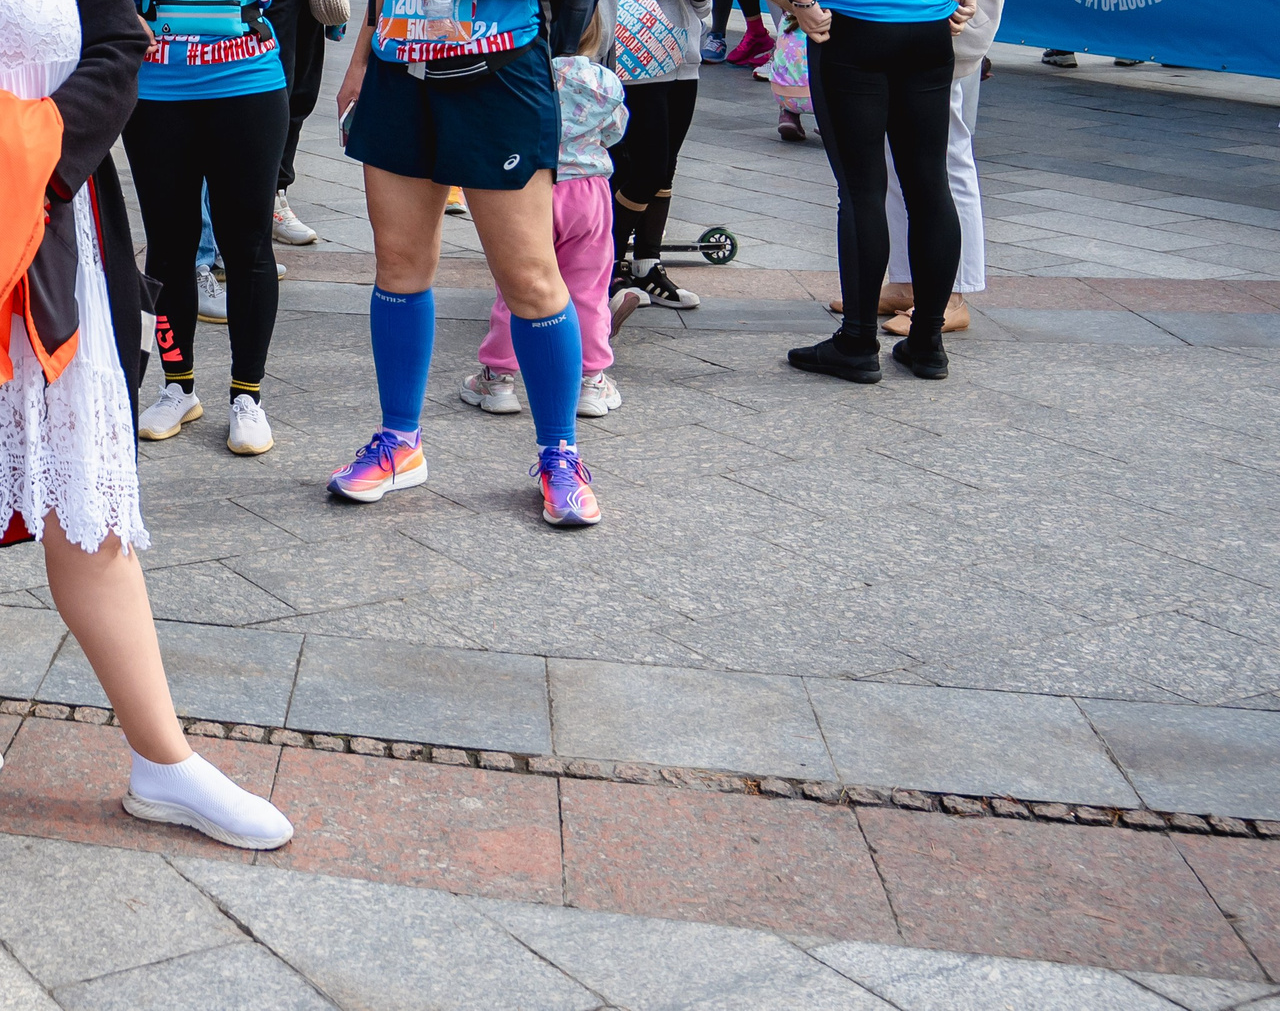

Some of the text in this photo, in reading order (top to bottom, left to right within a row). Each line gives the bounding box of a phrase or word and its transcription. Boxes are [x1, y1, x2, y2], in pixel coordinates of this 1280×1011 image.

[614, 23, 641, 55] #ГОРДО
[621, 54, 635, 69] ПСБ
[375, 291, 407, 304] RIMIX
[531, 314, 568, 328] RIMIX
